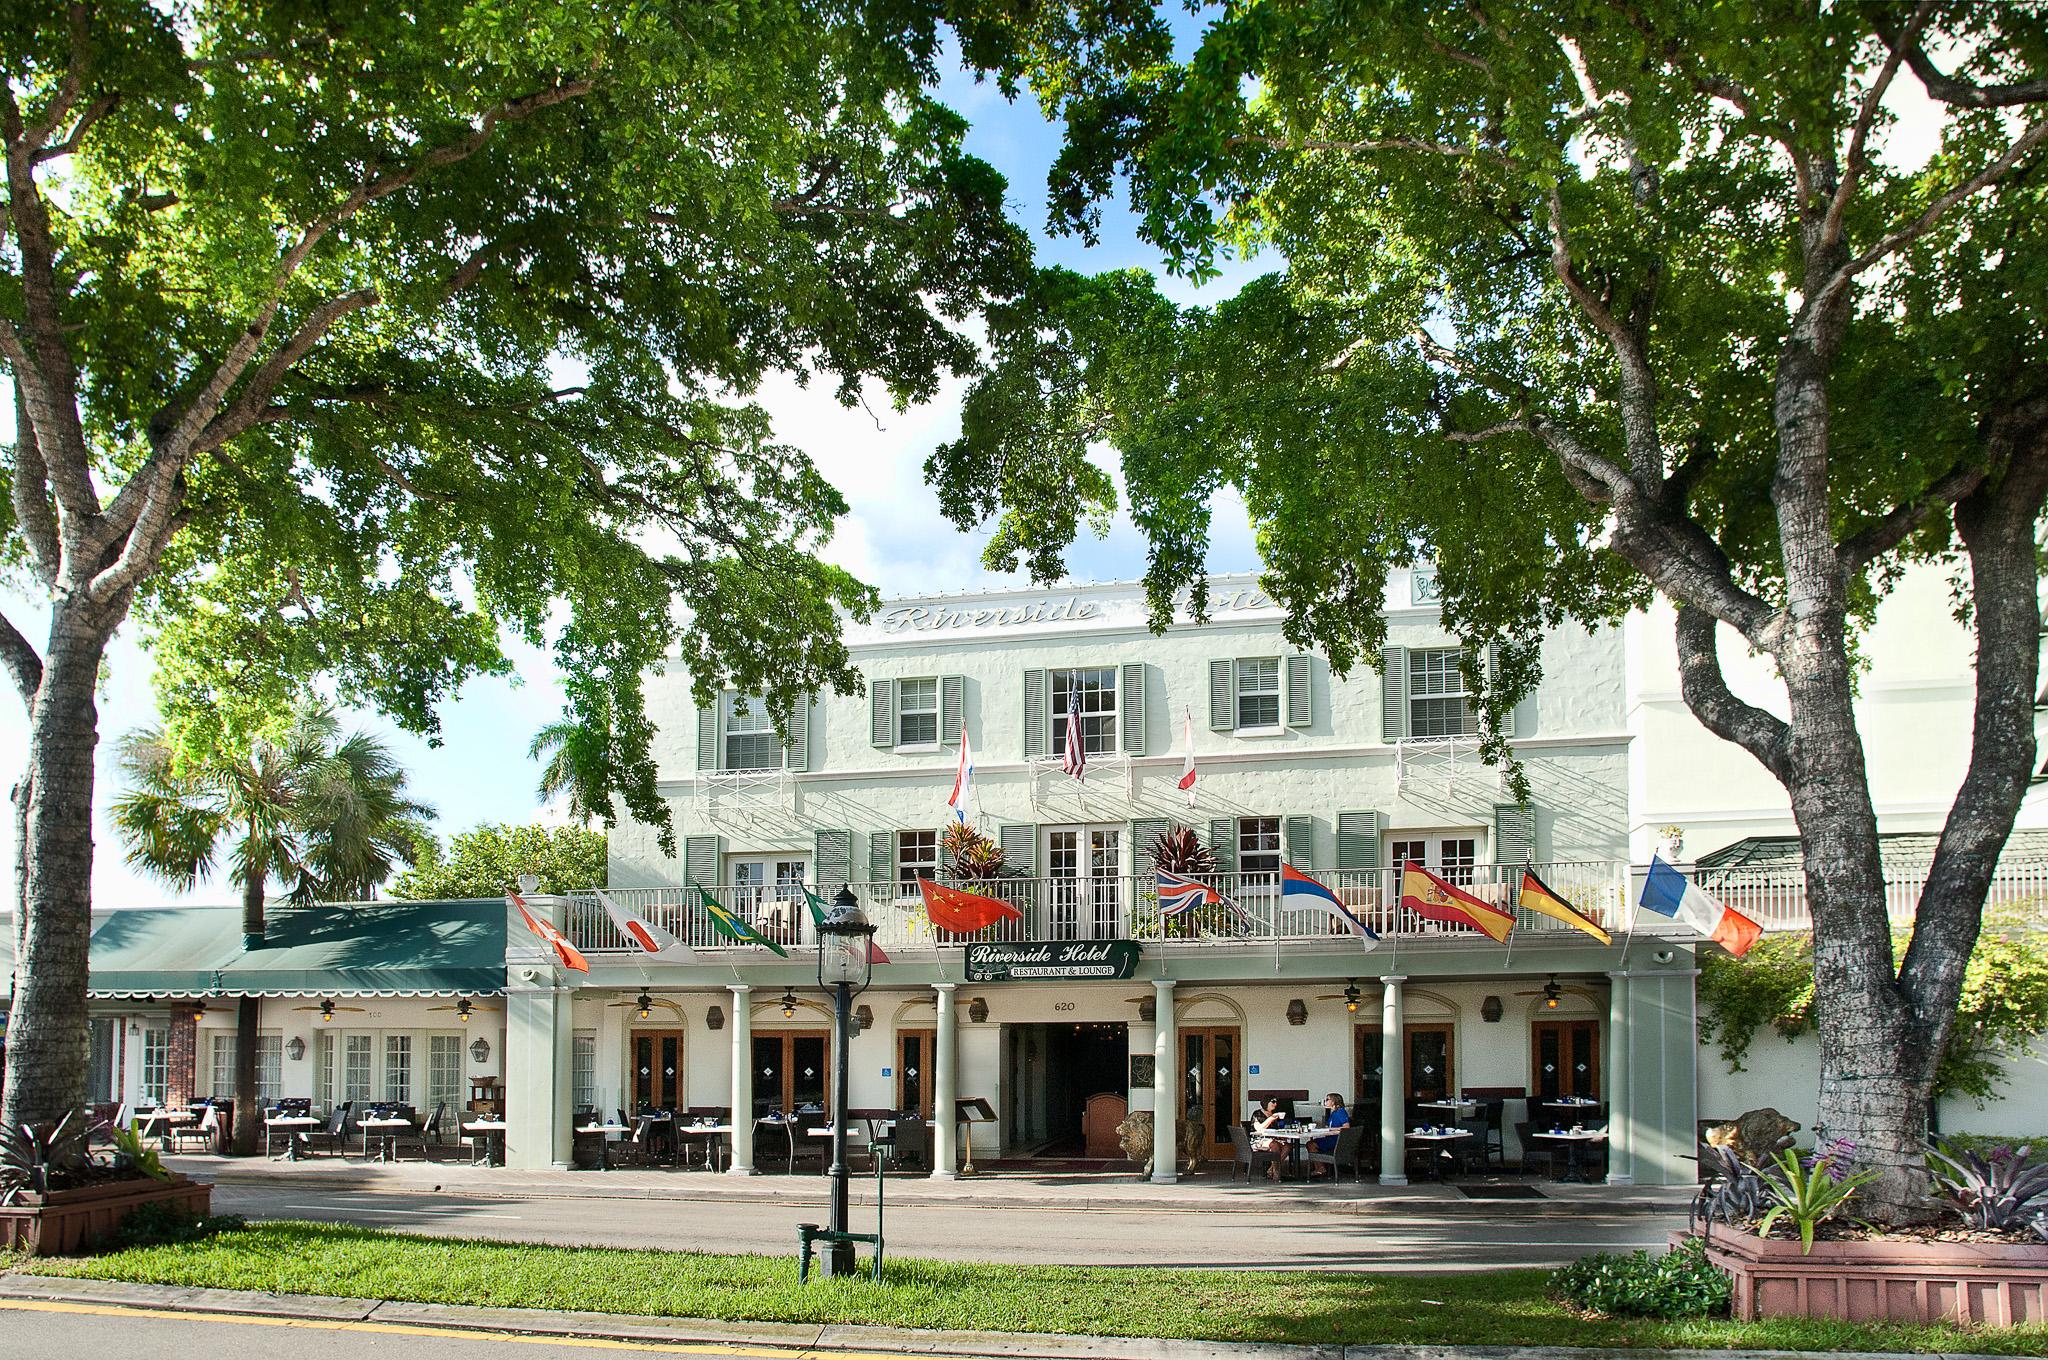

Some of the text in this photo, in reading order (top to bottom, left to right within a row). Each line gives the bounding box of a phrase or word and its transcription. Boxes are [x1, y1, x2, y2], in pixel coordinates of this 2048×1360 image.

[881, 598, 1100, 633] Riverside
[970, 943, 1112, 963] Riverside Hotel
[1013, 966, 1113, 976] RESTAURANT & LOUNGE
[1054, 1002, 1075, 1011] 620
